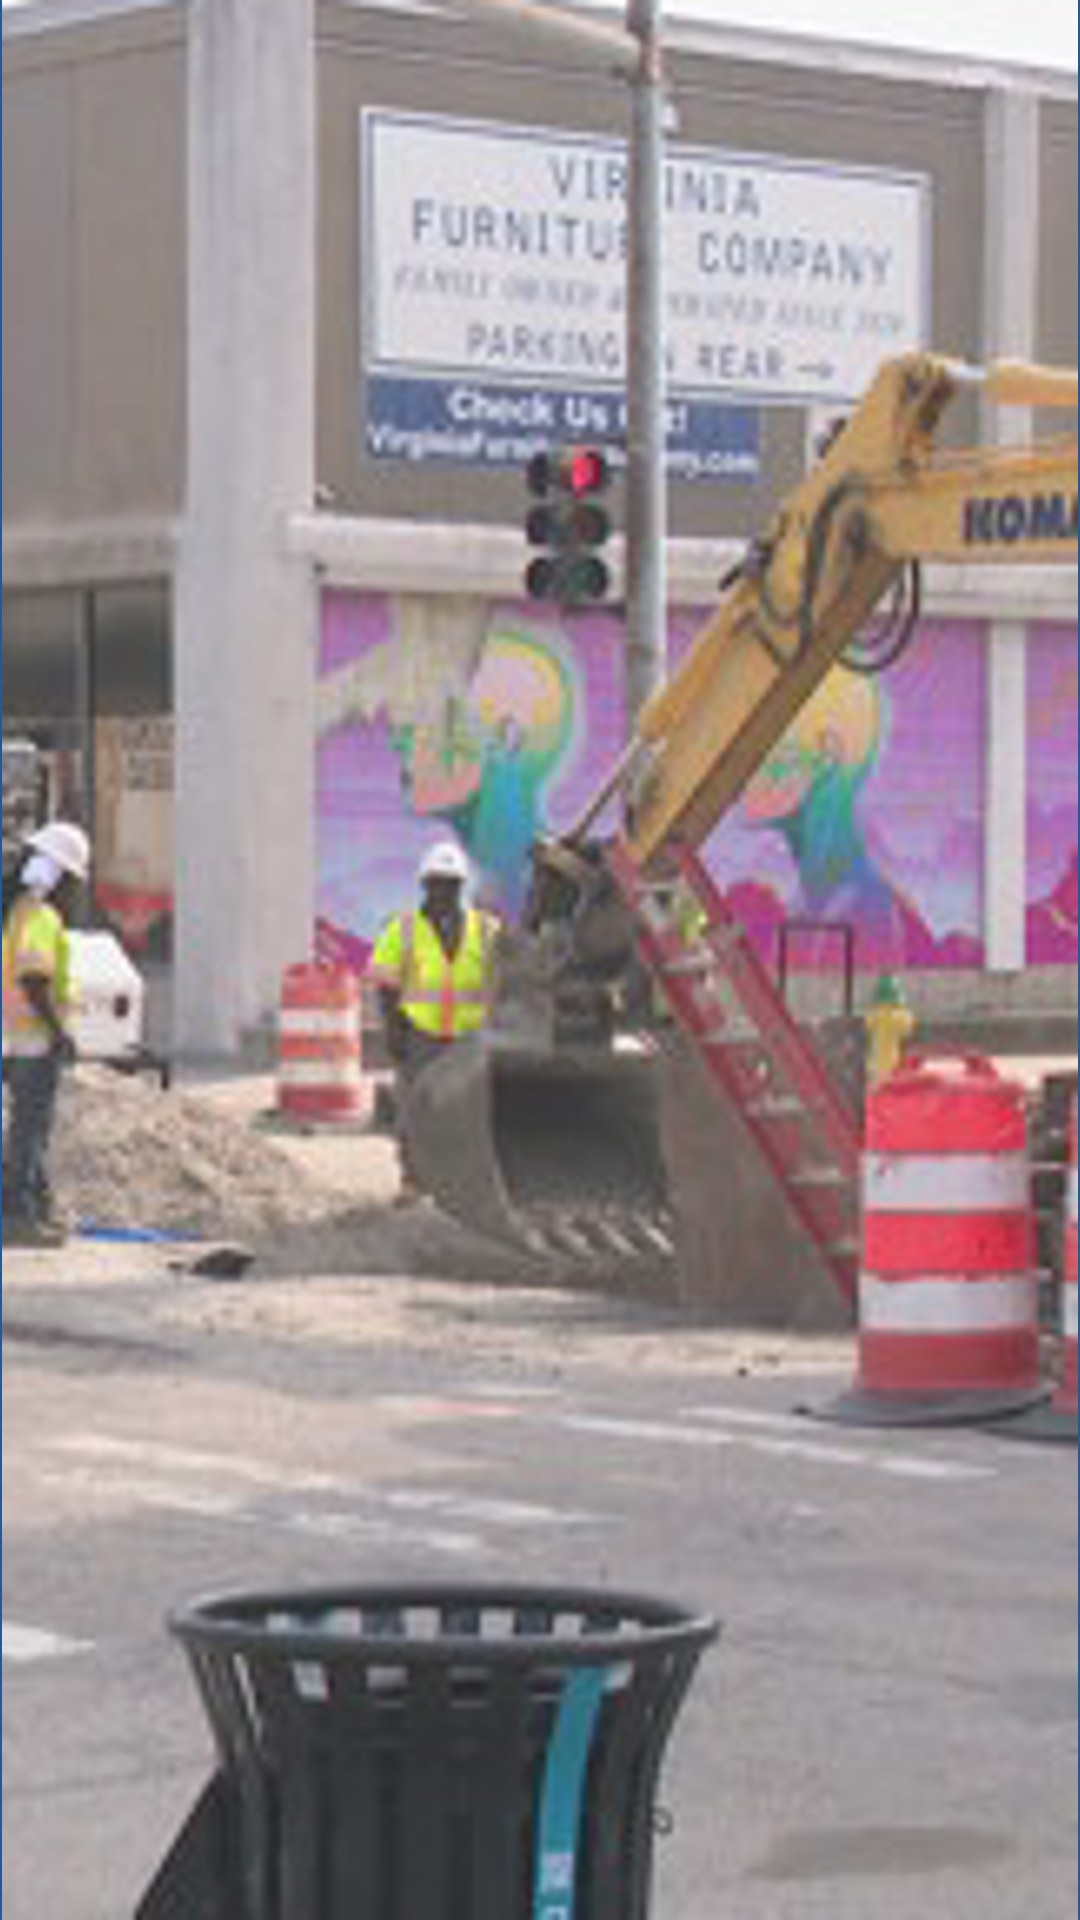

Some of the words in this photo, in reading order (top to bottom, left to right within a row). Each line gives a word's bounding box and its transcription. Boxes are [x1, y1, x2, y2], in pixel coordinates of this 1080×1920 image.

[549, 156, 761, 219] VIRINIA
[412, 198, 628, 260] FURNITU
[699, 230, 893, 286] COMPANY
[466, 323, 622, 369] PARKING
[698, 344, 784, 381] REAR
[446, 387, 553, 428] Check
[566, 398, 608, 431] Us
